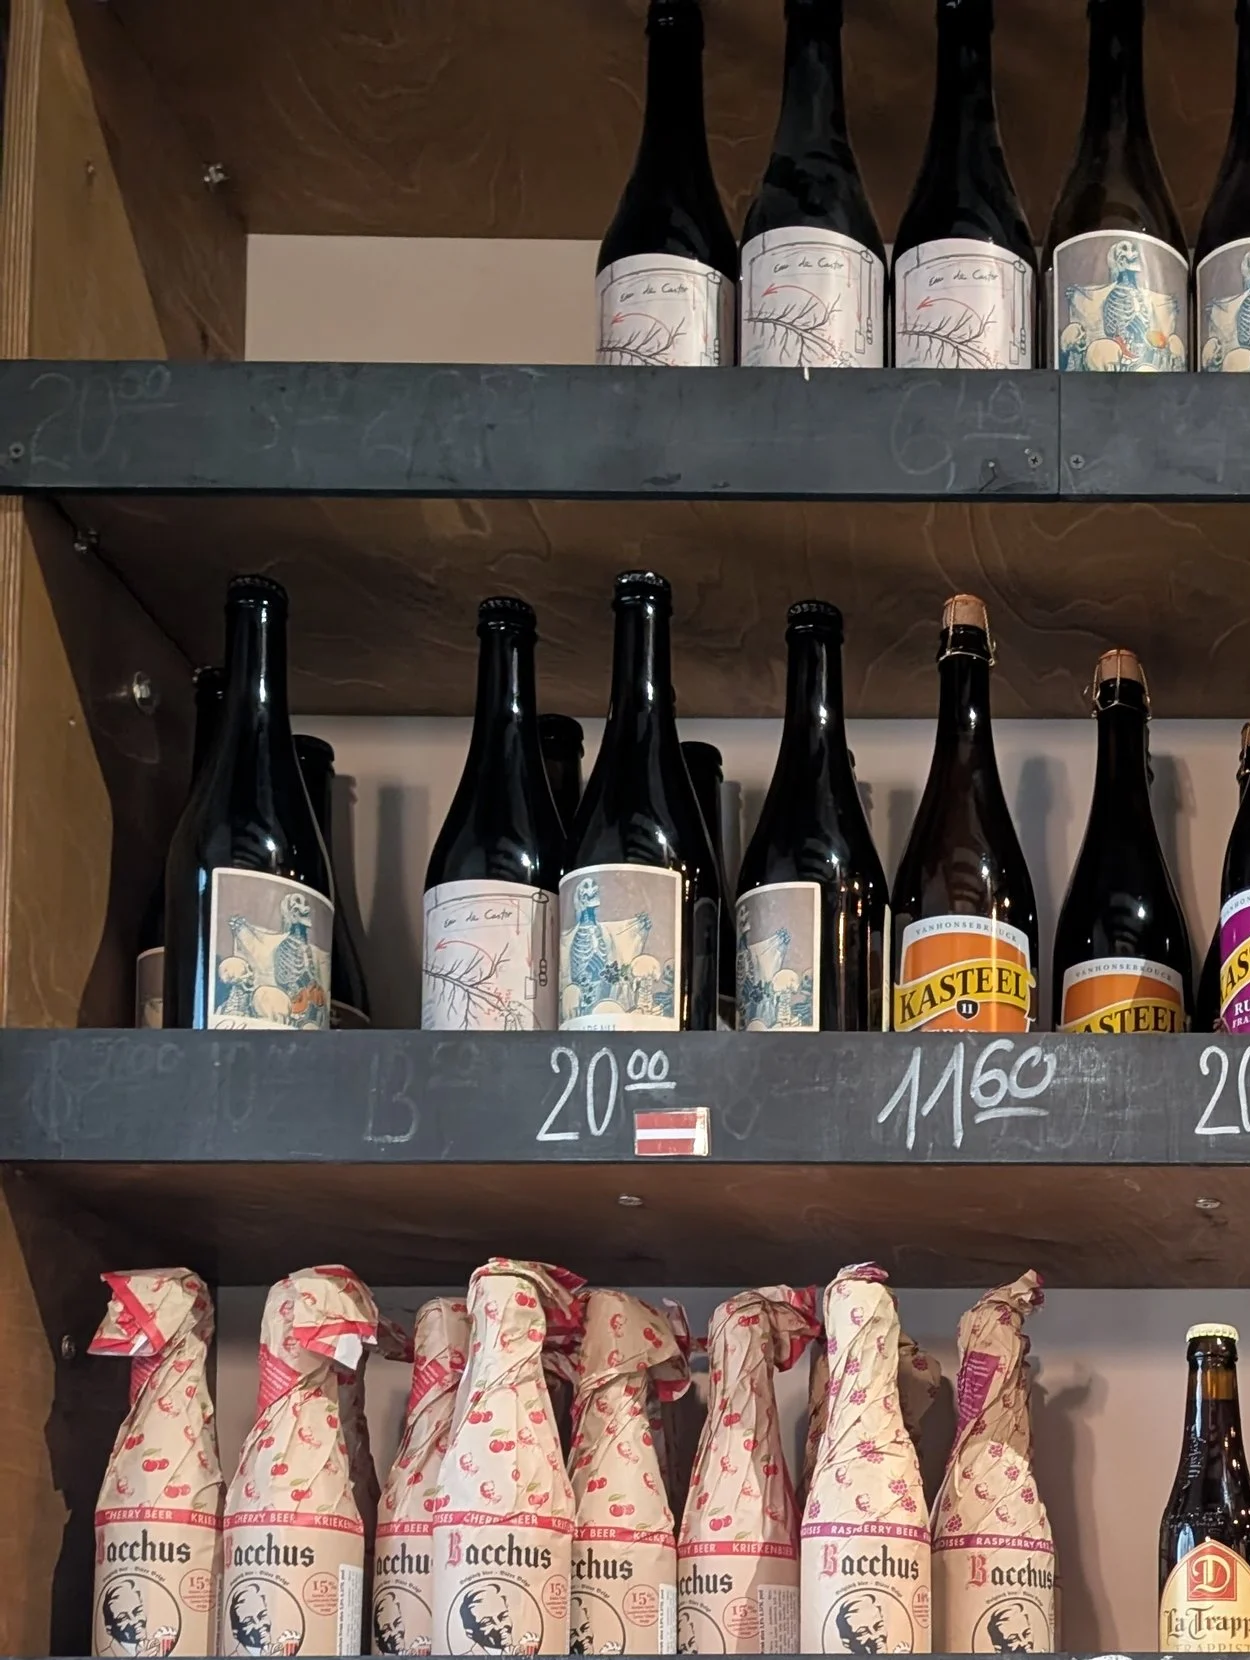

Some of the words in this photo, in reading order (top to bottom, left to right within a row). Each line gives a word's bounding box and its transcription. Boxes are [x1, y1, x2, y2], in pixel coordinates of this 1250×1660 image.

[899, 965, 1028, 1026] KASTEEL
[105, 1509, 141, 1521] CHERRY
[143, 1510, 174, 1520] BEER
[404, 1524, 430, 1533] BEER
[590, 1529, 617, 1539] BEER
[694, 1544, 717, 1554] BEER
[446, 1532, 552, 1571] Bacchus
[817, 1544, 920, 1581] Bacchus
[965, 1554, 1054, 1591] Bacchus
[1163, 1608, 1186, 1639] La
